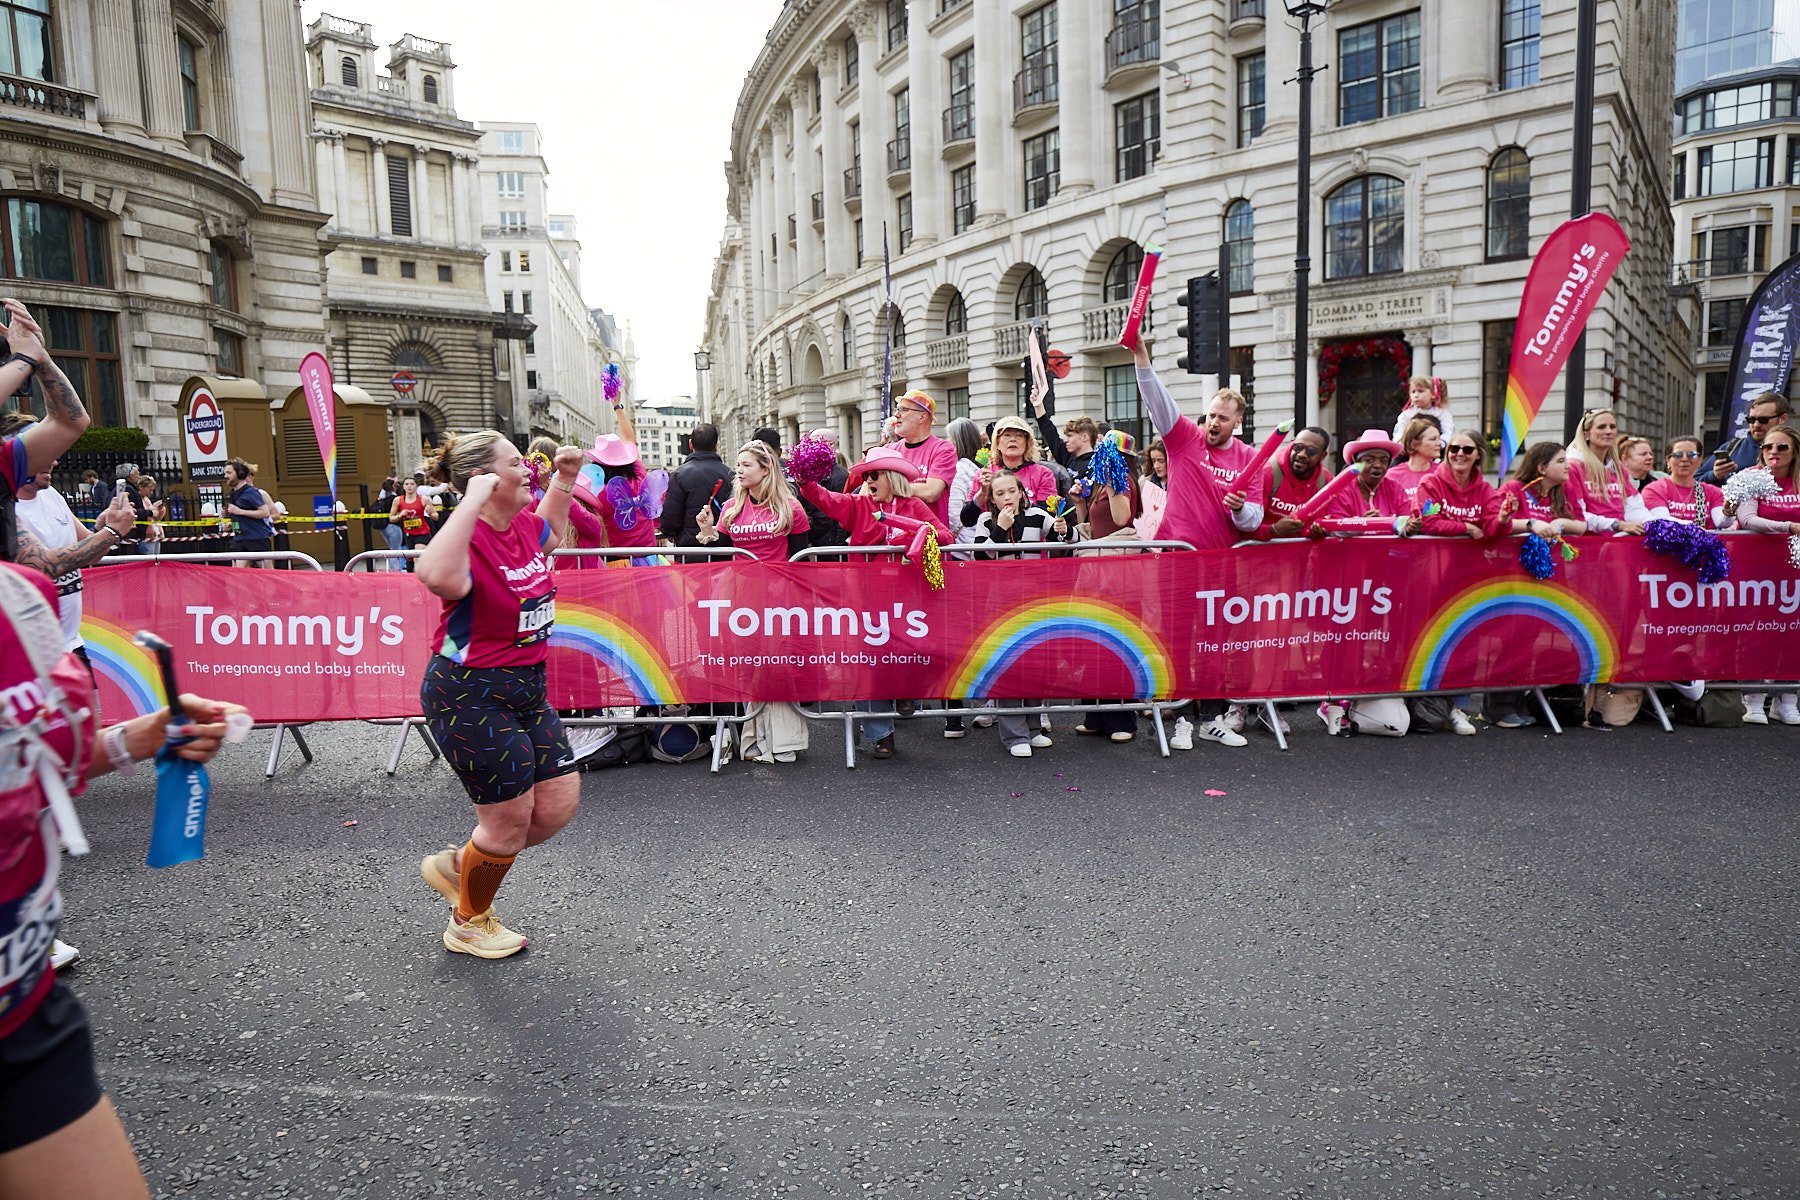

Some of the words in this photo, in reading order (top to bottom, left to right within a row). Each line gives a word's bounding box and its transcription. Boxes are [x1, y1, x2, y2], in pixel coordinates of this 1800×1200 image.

[1132, 285, 1150, 319] Tommy's
[1316, 302, 1374, 317] LOMBARD
[1379, 297, 1423, 310] STREET
[1524, 243, 1596, 356] Tommy's
[1543, 352, 1554, 366] The
[1552, 315, 1575, 354] pregnancy
[1572, 299, 1583, 315] and
[1579, 278, 1594, 299] baby
[1591, 251, 1610, 279] charity
[1744, 303, 1792, 374] TRAK
[188, 418, 222, 431] UNDERGROUND
[192, 467, 206, 477] BANK
[1196, 579, 1393, 626] Tommy's
[1638, 574, 1800, 614] Tommy
[185, 605, 404, 656] Tommy's
[698, 599, 929, 646] Tommy's
[1641, 624, 1663, 635] The
[1667, 624, 1730, 636] pregnancy
[1733, 621, 1755, 632] and
[1757, 620, 1787, 632] baby
[1197, 642, 1218, 653] The
[1222, 637, 1285, 653] pregnancy
[1287, 632, 1310, 645] and
[1313, 630, 1342, 643] baby
[1345, 628, 1390, 643] charity
[187, 661, 209, 673] The
[213, 663, 281, 677] pregnancy
[284, 662, 311, 674] and
[315, 662, 351, 677] baby
[355, 662, 405, 677] charity
[699, 654, 725, 666] The
[729, 655, 805, 668] pregnancy
[808, 652, 836, 665] and
[840, 652, 877, 666] baby
[881, 652, 931, 666] charity
